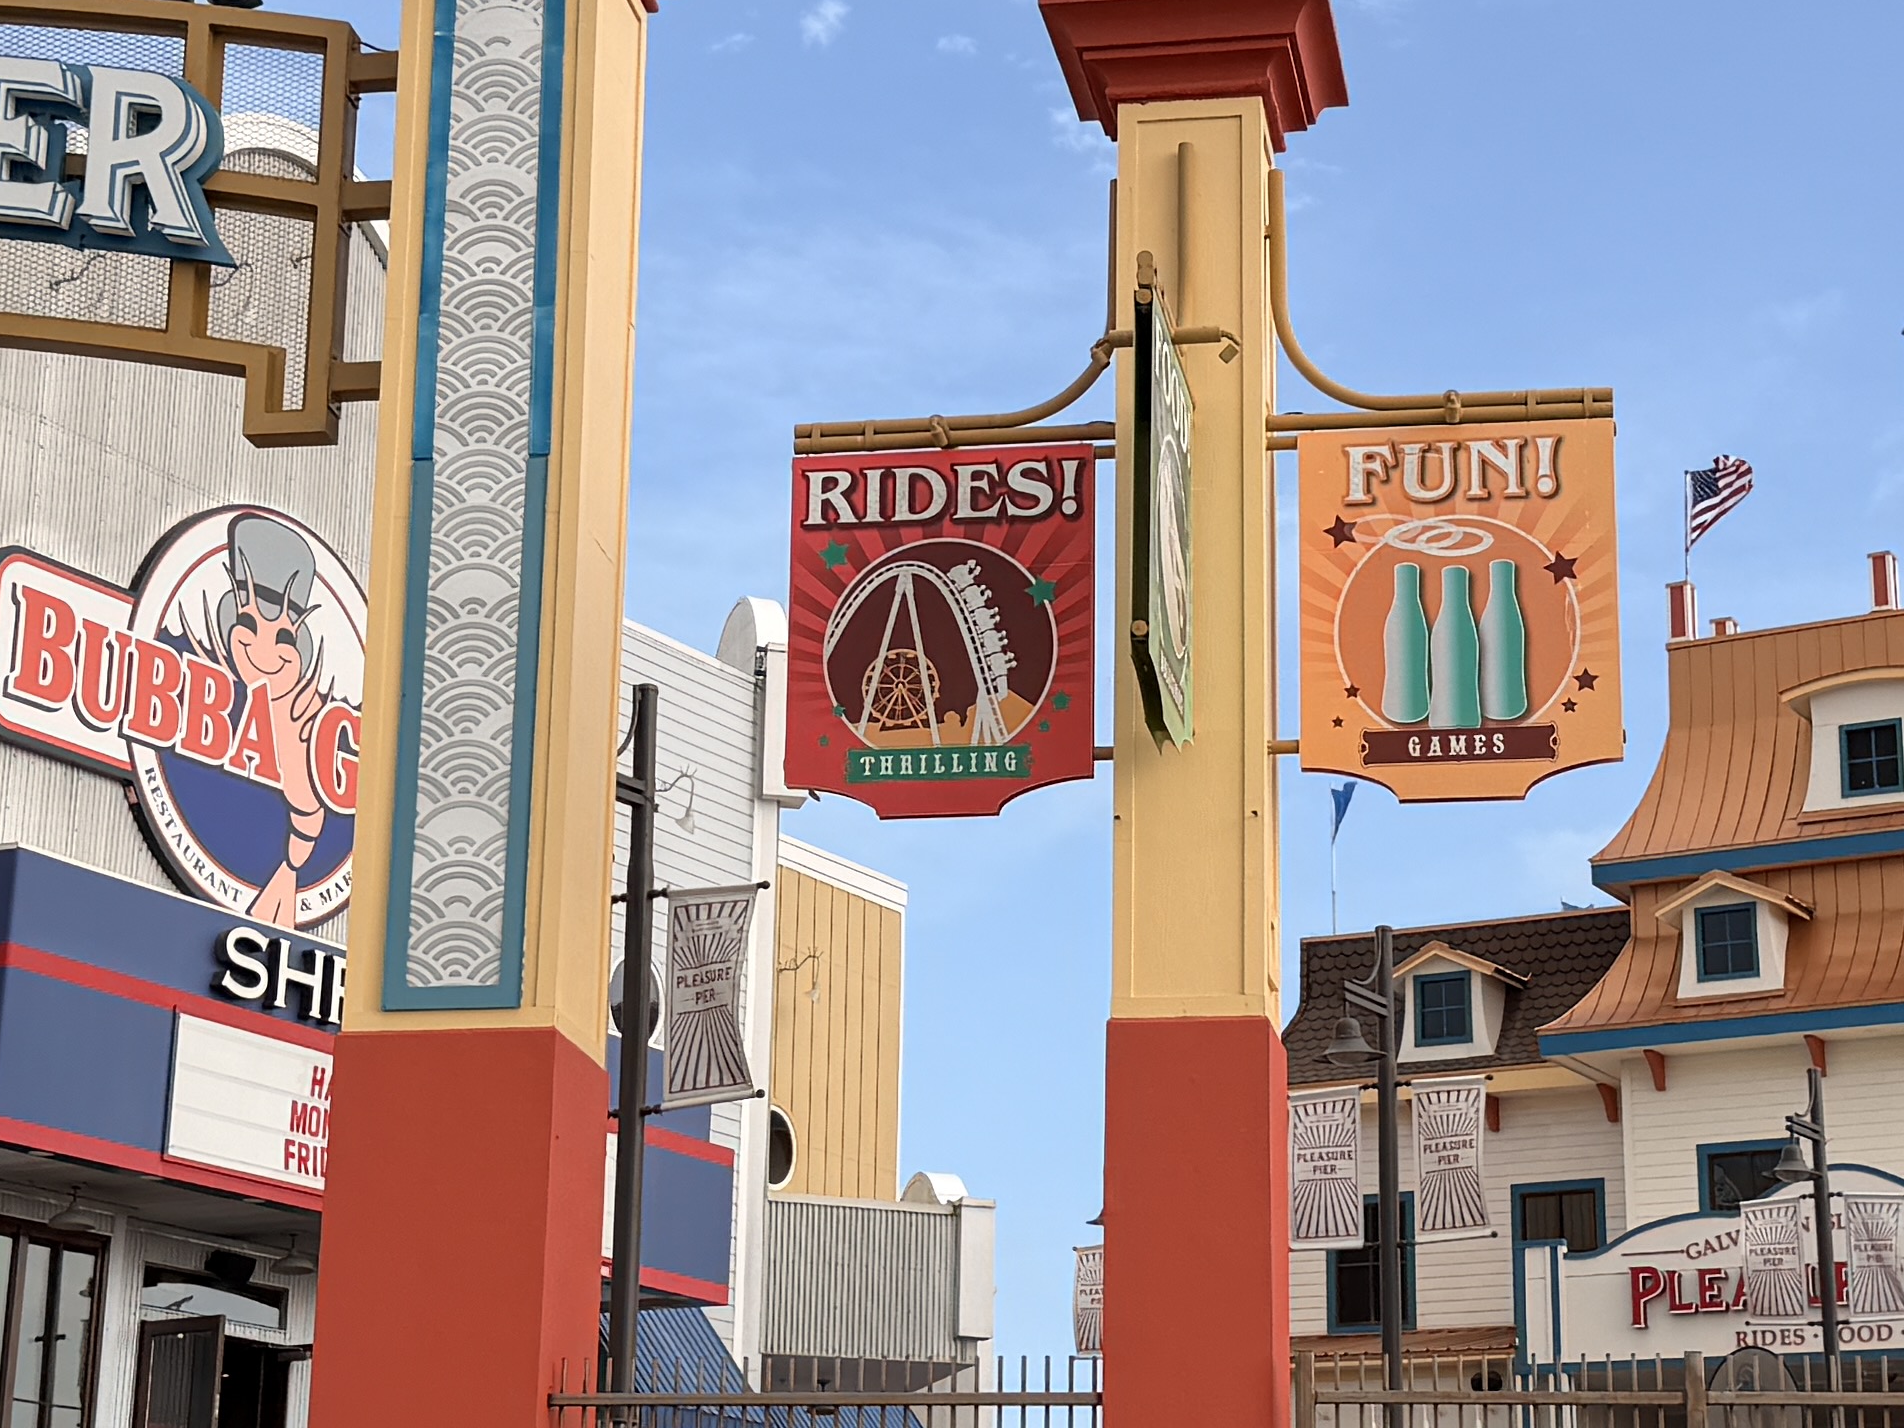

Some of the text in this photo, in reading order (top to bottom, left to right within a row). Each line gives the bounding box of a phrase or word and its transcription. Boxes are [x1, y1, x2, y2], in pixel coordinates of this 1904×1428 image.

[1343, 435, 1564, 506] FUN!
[800, 458, 1084, 528] RIDES!
[5, 582, 284, 788] BUBBA
[1408, 732, 1506, 757] GAMES
[860, 751, 1018, 777] THRILLING
[145, 767, 244, 903] RESTAURANT
[300, 897, 312, 913] &
[677, 967, 733, 989] PLEASURE
[1297, 1150, 1354, 1163] PLEASURE
[1424, 1138, 1475, 1154] PLEASURE
[1313, 1164, 1338, 1176] PIER
[1438, 1154, 1460, 1166] PIER
[1749, 1245, 1796, 1257] PLEASURE
[1736, 1328, 1806, 1348] RIDES
[1839, 1323, 1893, 1344] OOD
